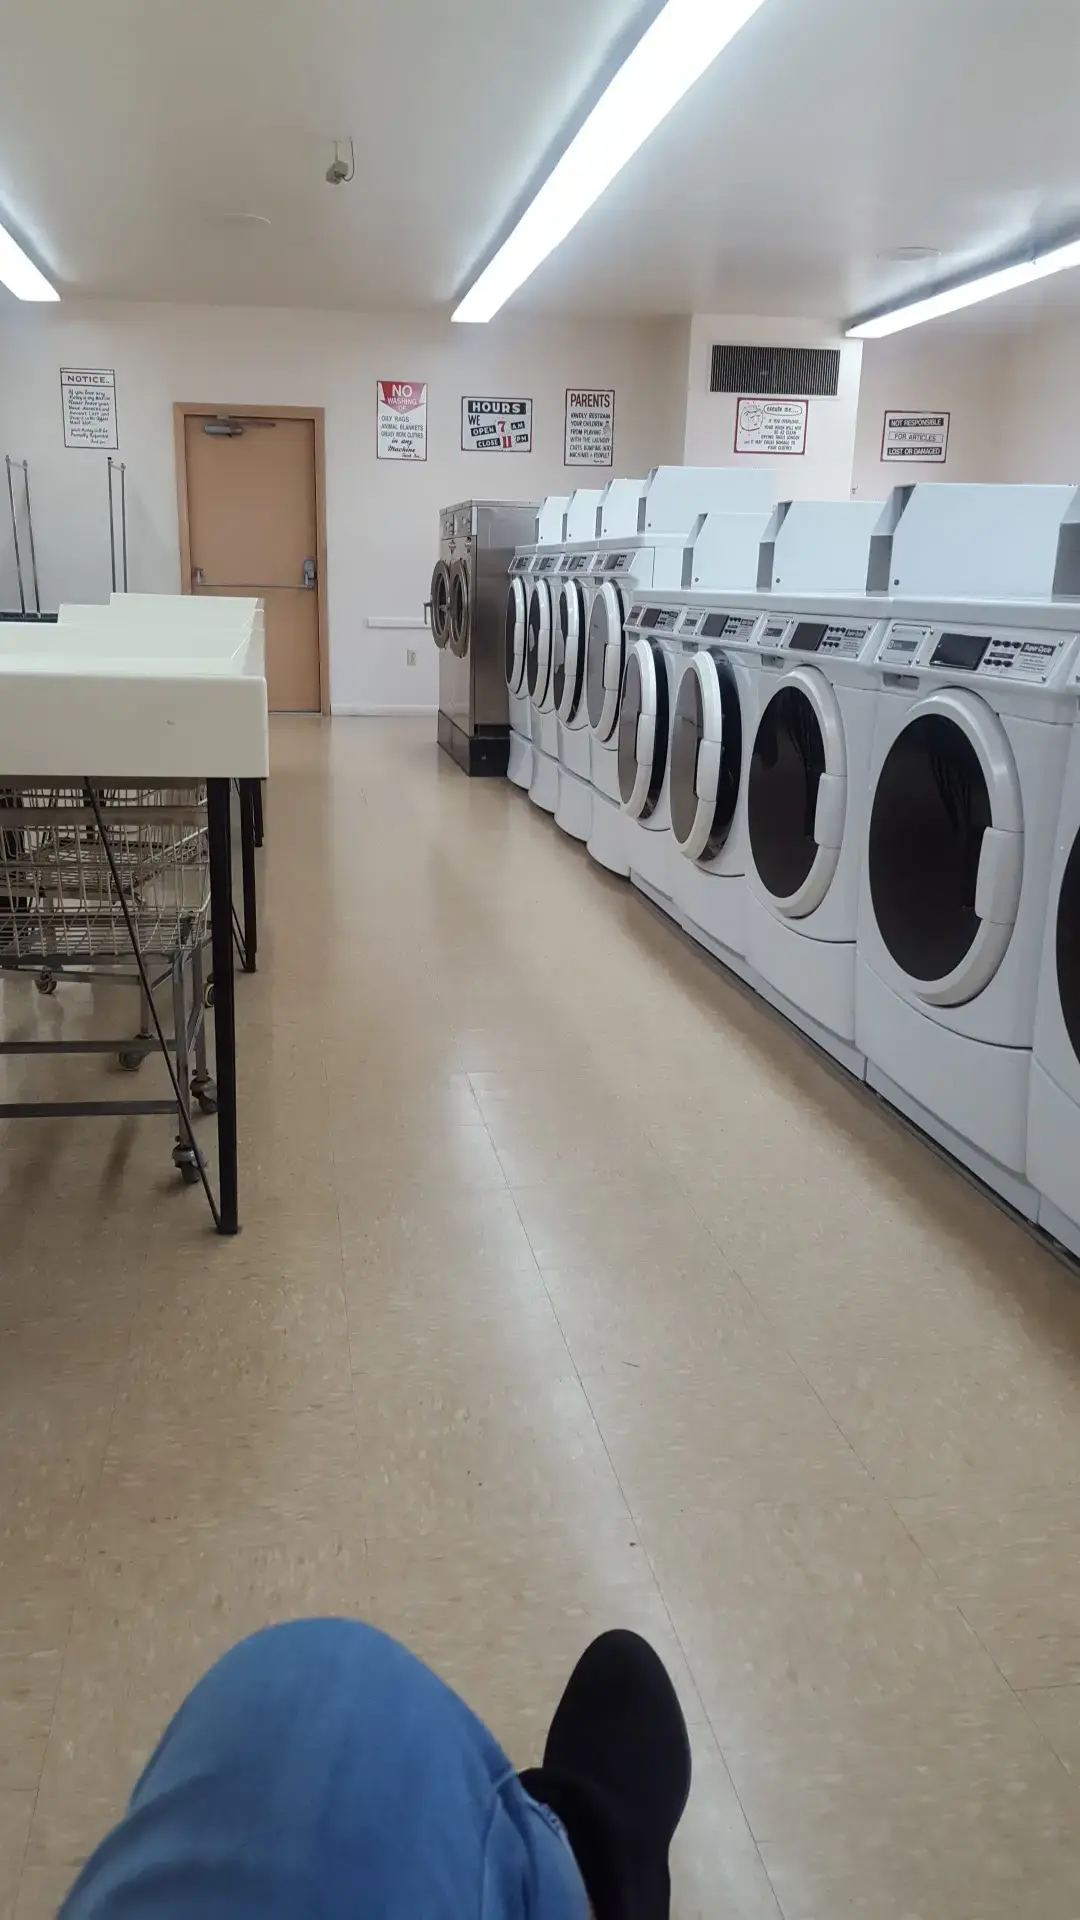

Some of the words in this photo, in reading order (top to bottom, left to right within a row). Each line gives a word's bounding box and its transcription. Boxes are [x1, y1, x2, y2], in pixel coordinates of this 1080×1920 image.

[392, 384, 412, 397] NO
[570, 394, 610, 408] PARENTS
[472, 402, 520, 413] HOURS
[468, 415, 480, 426] WE
[473, 427, 494, 435] OPEN
[498, 421, 506, 432] 7
[502, 436, 512, 448] 11
[909, 434, 936, 442] ARTICLES
